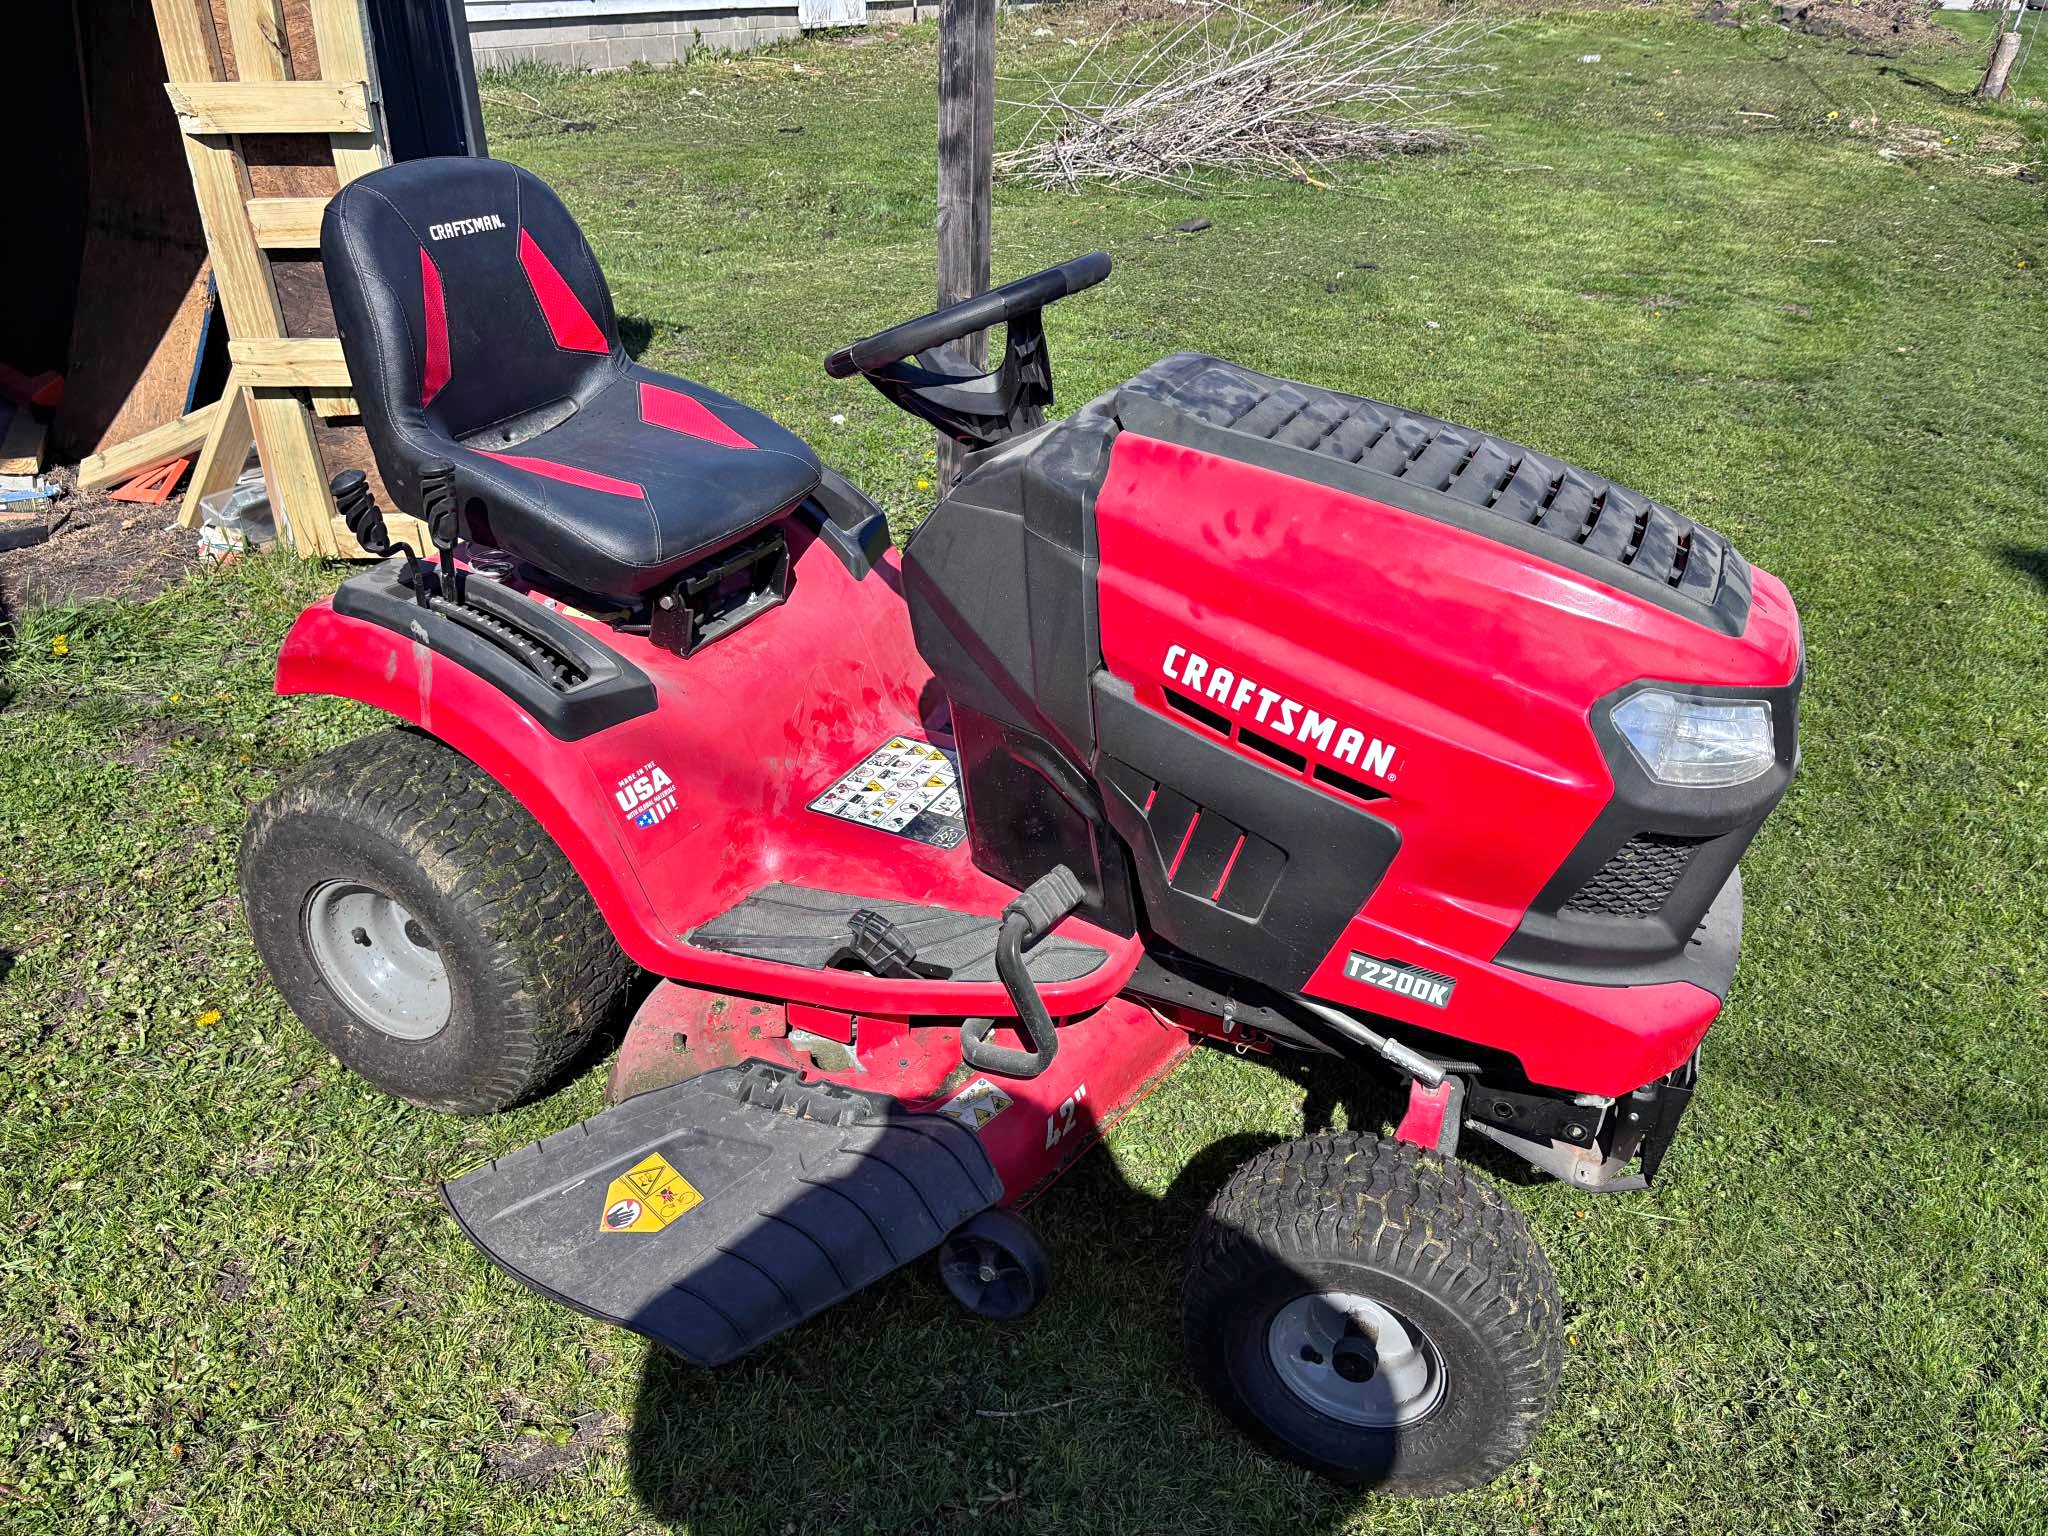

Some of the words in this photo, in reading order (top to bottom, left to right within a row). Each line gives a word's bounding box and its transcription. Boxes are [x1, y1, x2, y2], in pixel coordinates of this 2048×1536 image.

[429, 214, 505, 241] CRAFTSMAN
[1162, 644, 1397, 781] CRAFTSMAN
[615, 766, 673, 812] USA
[618, 773, 636, 788] MADE
[636, 768, 644, 776] IN
[644, 761, 656, 771] THE
[1349, 955, 1449, 1006] T2200K
